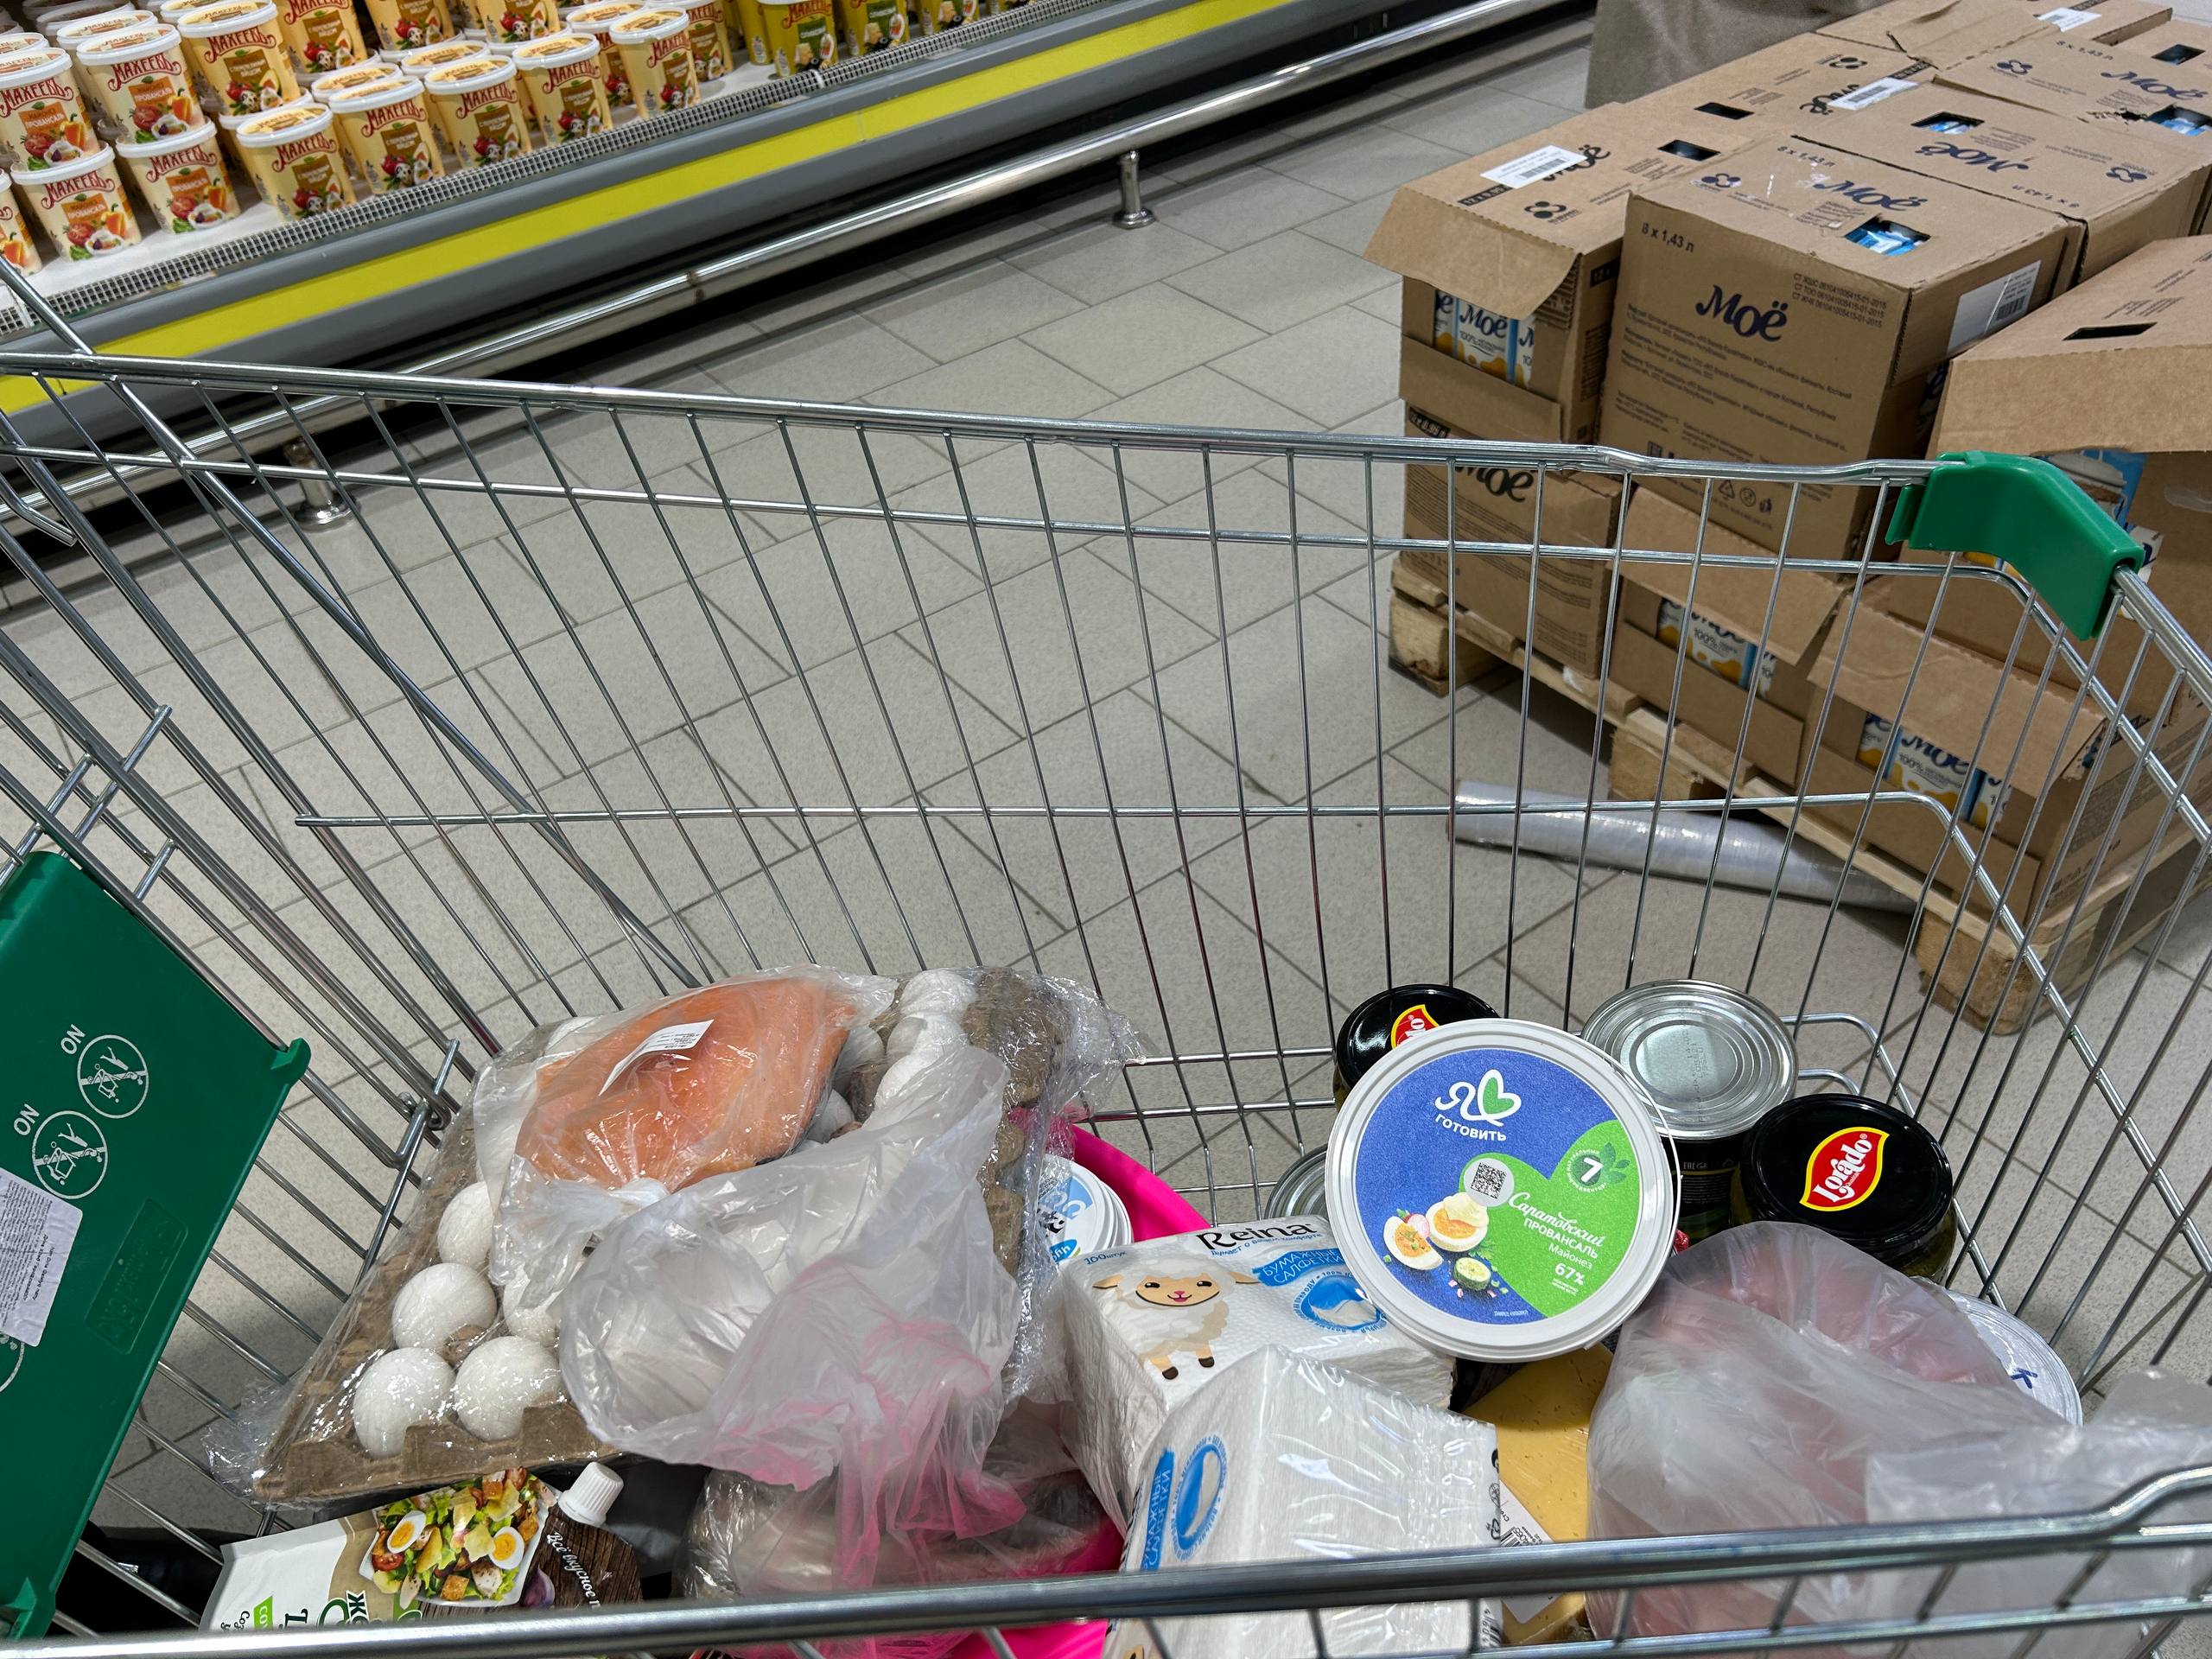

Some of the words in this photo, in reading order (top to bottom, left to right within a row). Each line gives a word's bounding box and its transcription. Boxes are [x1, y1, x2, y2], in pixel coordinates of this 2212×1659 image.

[1813, 180, 1928, 211] Моё
[1661, 230, 1685, 250] 1,43
[1695, 284, 1788, 341] Моё
[1435, 1114, 1507, 1141] ГОТОВИТЬ
[1580, 1157, 1604, 1183] 7
[1812, 1139, 1872, 1203] Lorado
[1508, 1192, 1605, 1247] Саратовский
[1196, 1223, 1318, 1250] Reina
[1523, 1217, 1598, 1259] ПРОВАНСАЛЬ
[1548, 1243, 1592, 1269] Майонез
[1554, 1262, 1585, 1286] 67%
[547, 1531, 572, 1554] Всё
[563, 1554, 596, 1598] вкусное
